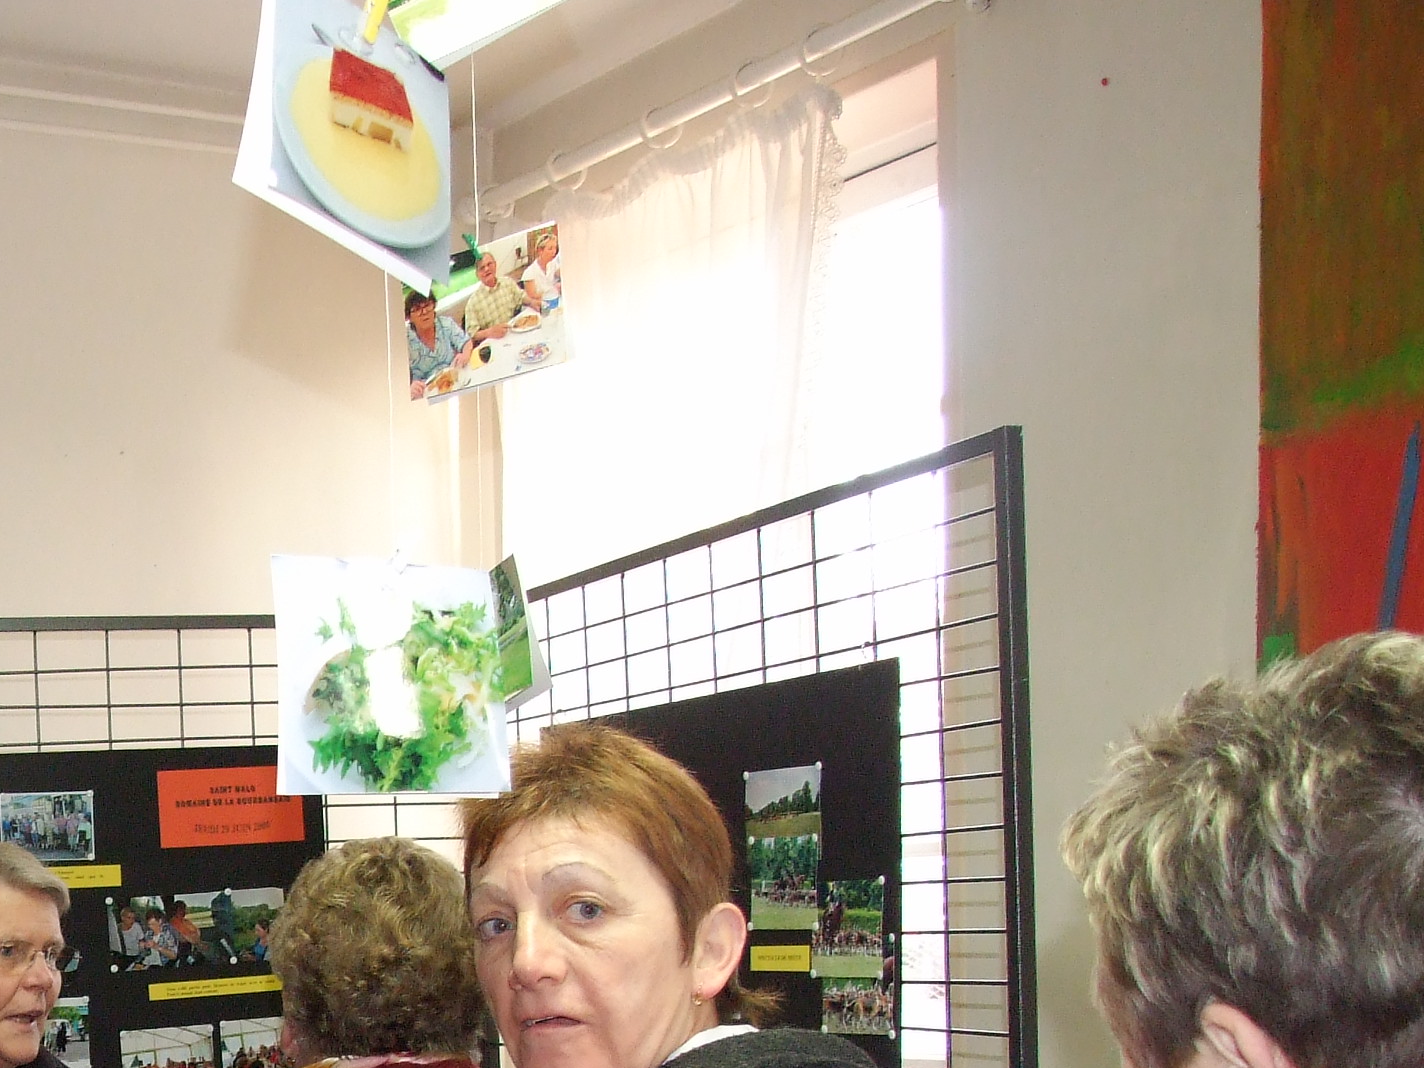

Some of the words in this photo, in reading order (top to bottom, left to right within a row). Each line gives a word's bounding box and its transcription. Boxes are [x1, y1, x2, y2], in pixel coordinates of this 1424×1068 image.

[209, 785, 232, 795] SAINT
[235, 784, 256, 794] MALO
[175, 798, 210, 808] DOMAINE
[225, 797, 234, 806] LA
